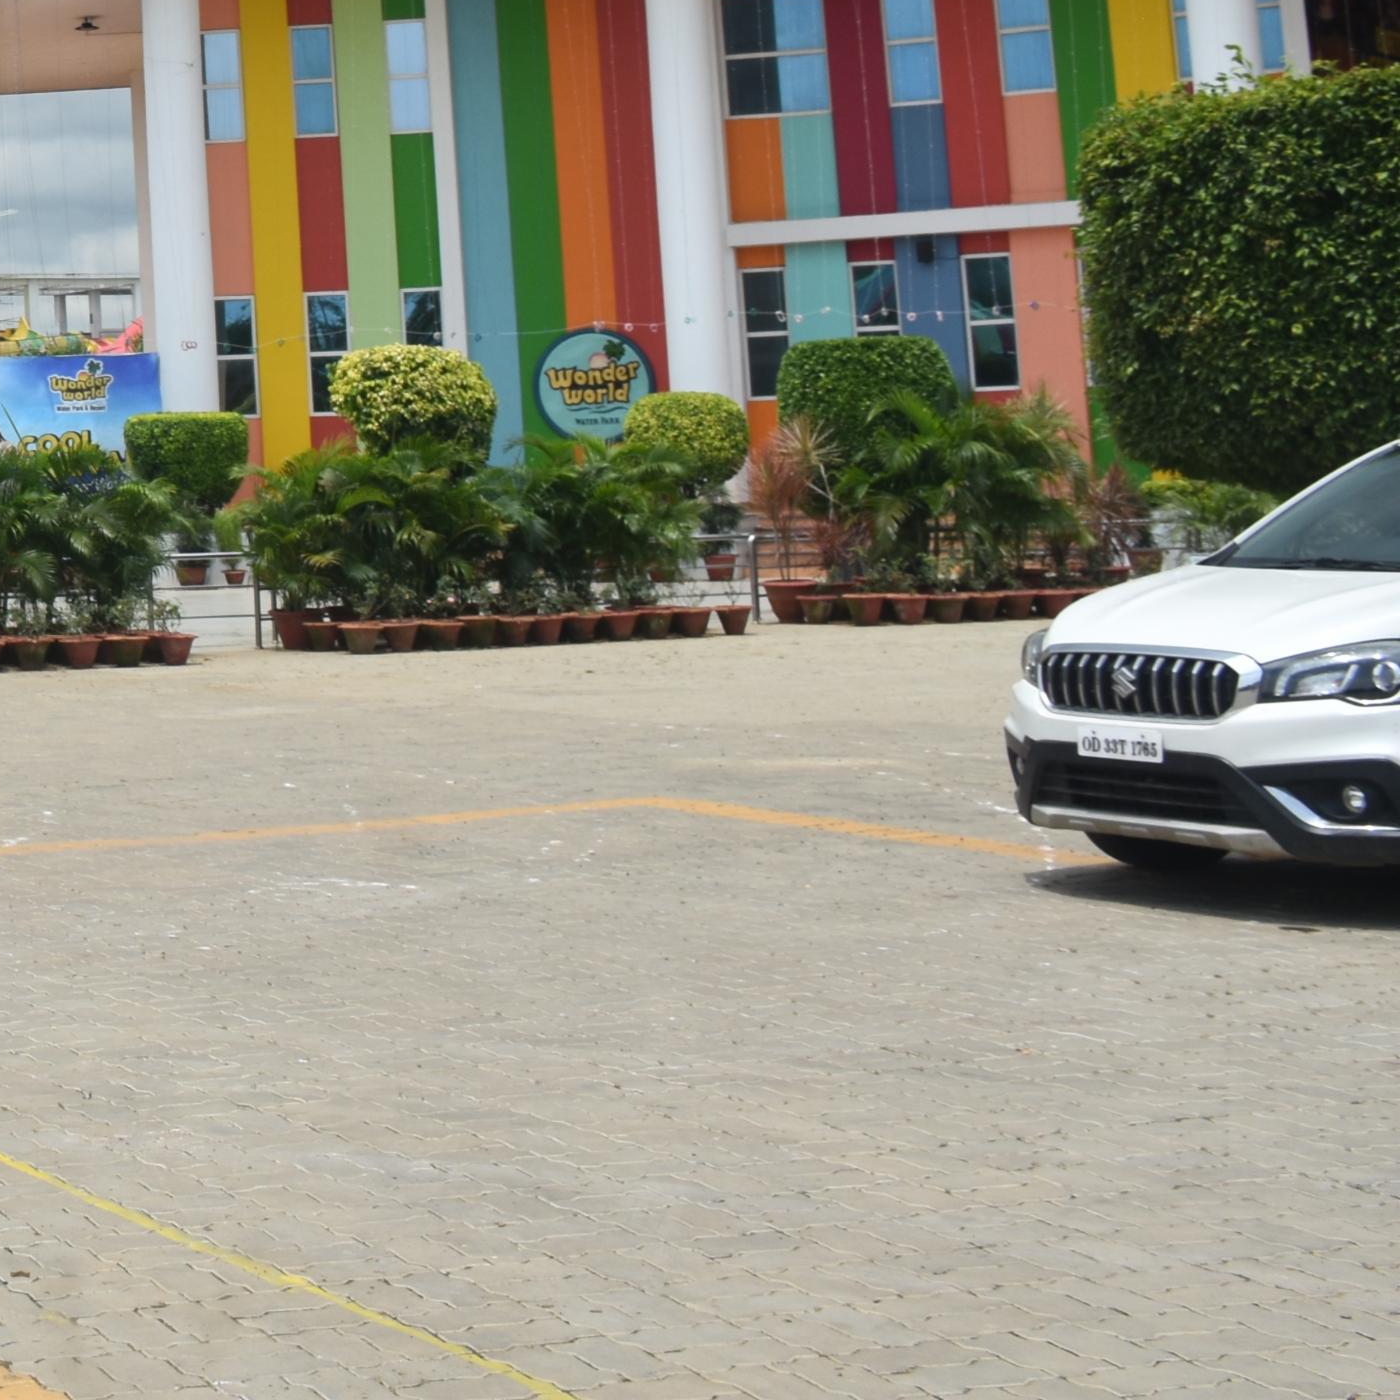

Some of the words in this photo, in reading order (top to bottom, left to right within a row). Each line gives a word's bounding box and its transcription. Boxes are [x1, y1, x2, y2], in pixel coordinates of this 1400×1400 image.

[50, 375, 112, 391] Wonder
[545, 360, 640, 390] Wonder
[63, 386, 106, 401] world
[562, 382, 630, 406] world
[1082, 736, 1101, 752] OD
